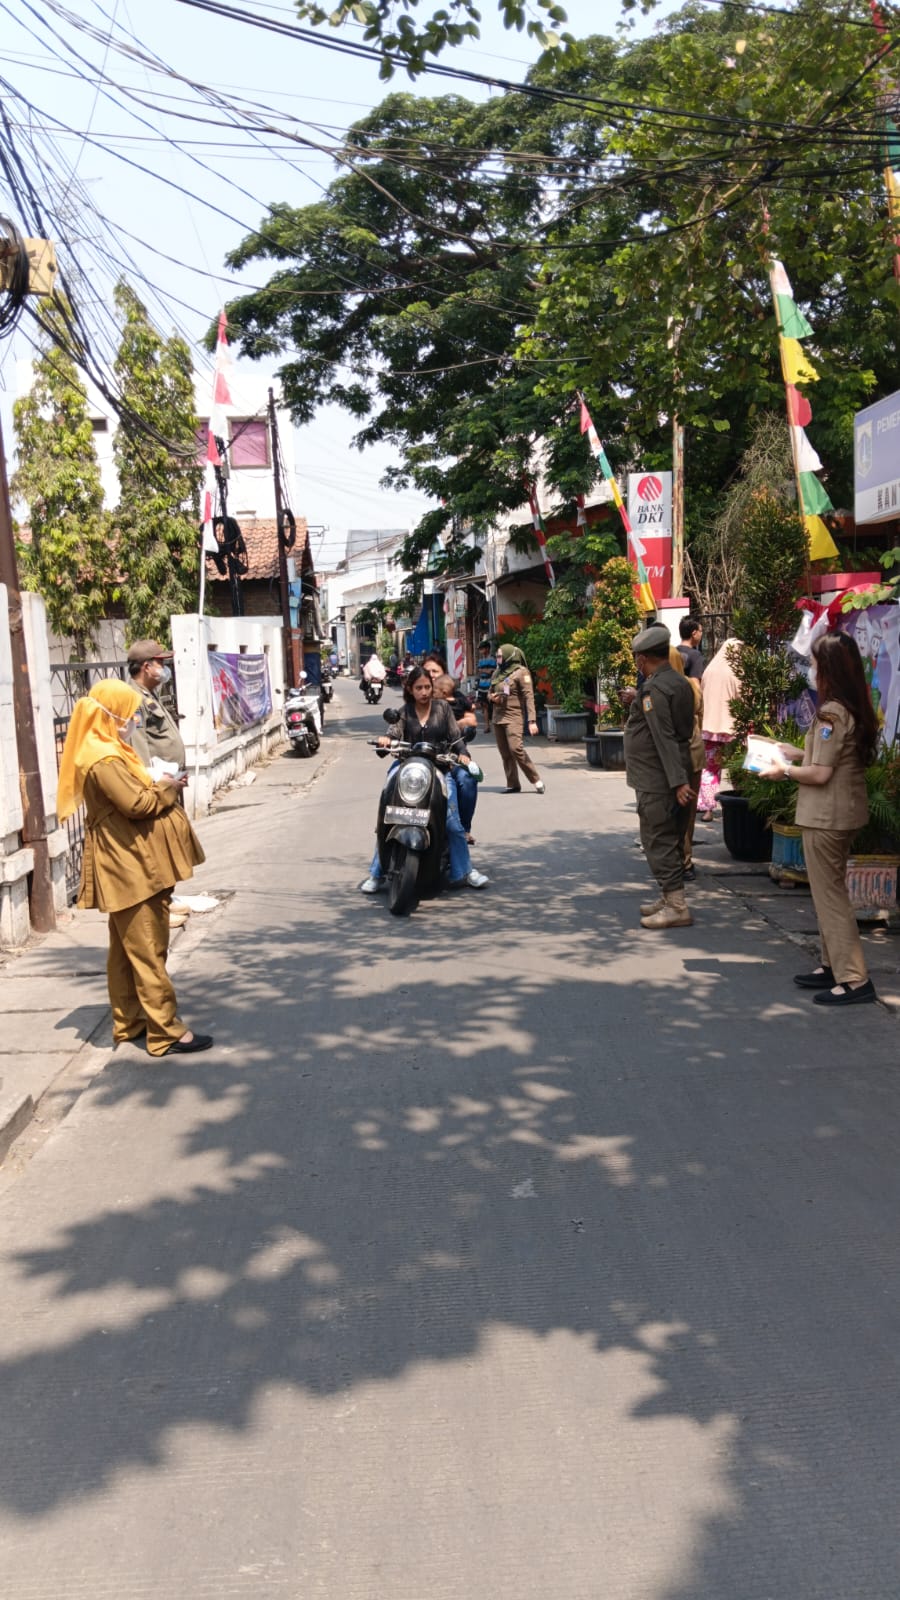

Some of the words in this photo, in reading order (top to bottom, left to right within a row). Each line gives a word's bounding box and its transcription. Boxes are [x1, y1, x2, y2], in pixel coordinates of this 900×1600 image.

[637, 504, 664, 513] BANK
[638, 512, 664, 524] DKI
[644, 566, 665, 578] TM
